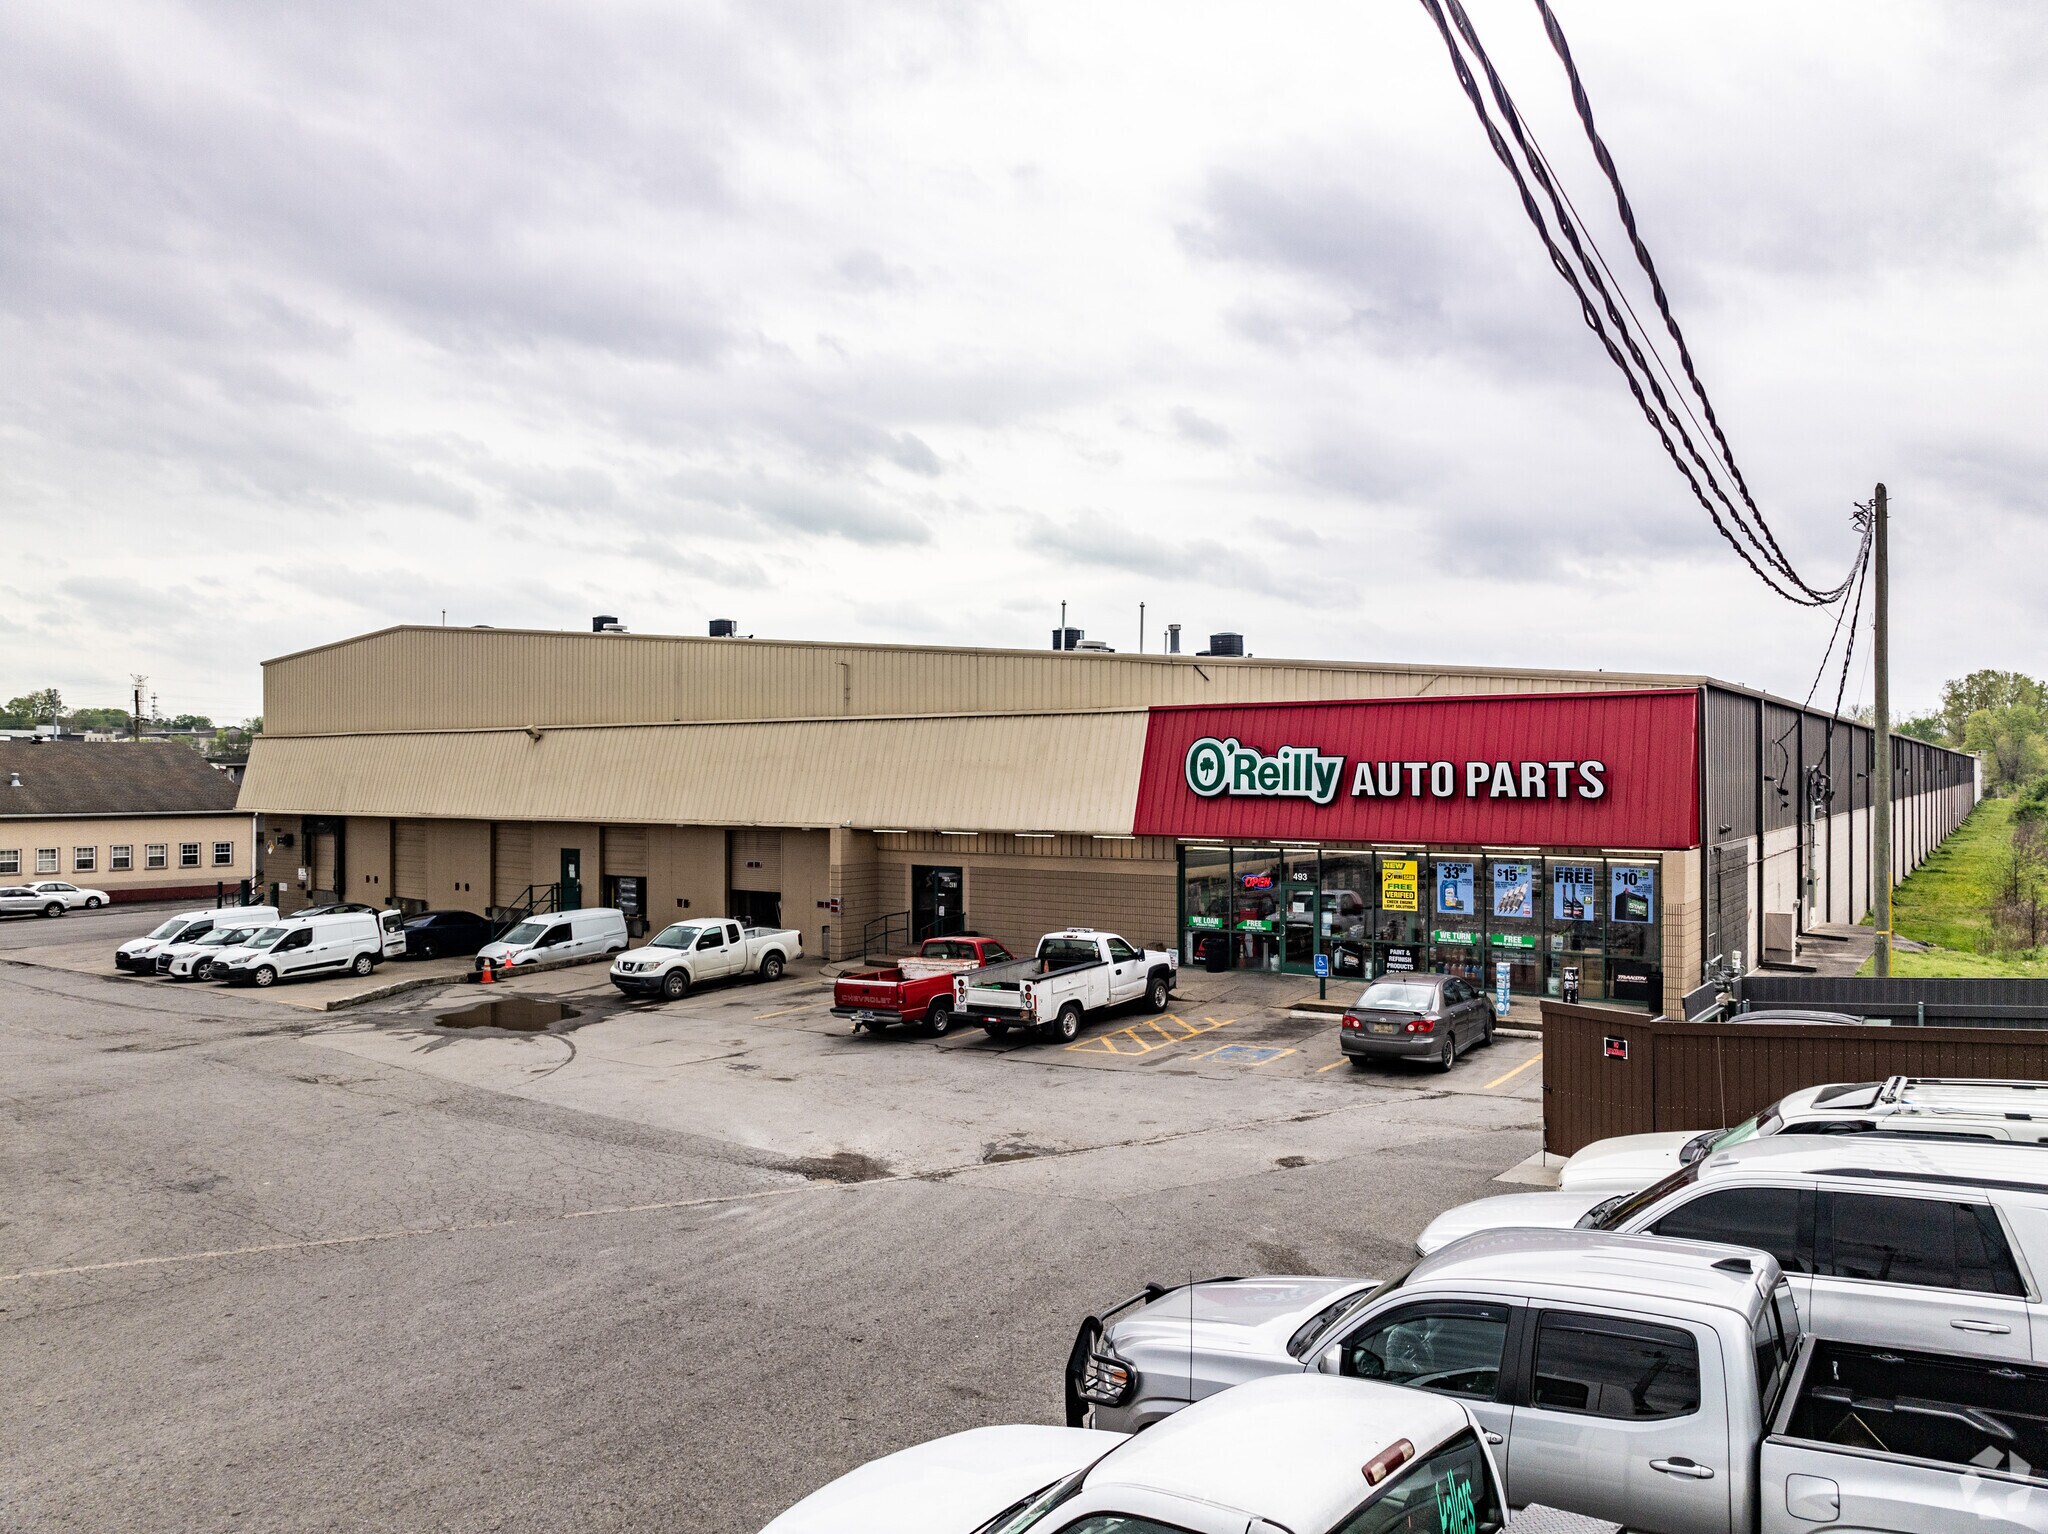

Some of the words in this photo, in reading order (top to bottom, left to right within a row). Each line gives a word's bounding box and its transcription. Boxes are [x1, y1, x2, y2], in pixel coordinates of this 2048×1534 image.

[1188, 739, 1343, 802] O'Reilly
[1351, 761, 1455, 798] AUTO
[1466, 759, 1606, 799] PARTS
[1292, 872, 1308, 882] 493
[1497, 868, 1518, 882] $15
[1555, 871, 1593, 884] FREE
[1615, 871, 1638, 886] $10
[1244, 876, 1271, 888] OPEN
[1385, 891, 1414, 899] VERIFIED
[1192, 916, 1202, 924] WE
[1203, 917, 1219, 925] LOAN
[1440, 931, 1451, 939] WE
[1452, 932, 1471, 941] TURN
[1503, 935, 1522, 944] FREE
[1389, 948, 1405, 956] PAINT
[1388, 955, 1412, 963] REFINISH
[841, 994, 891, 1004] CHEVROLET
